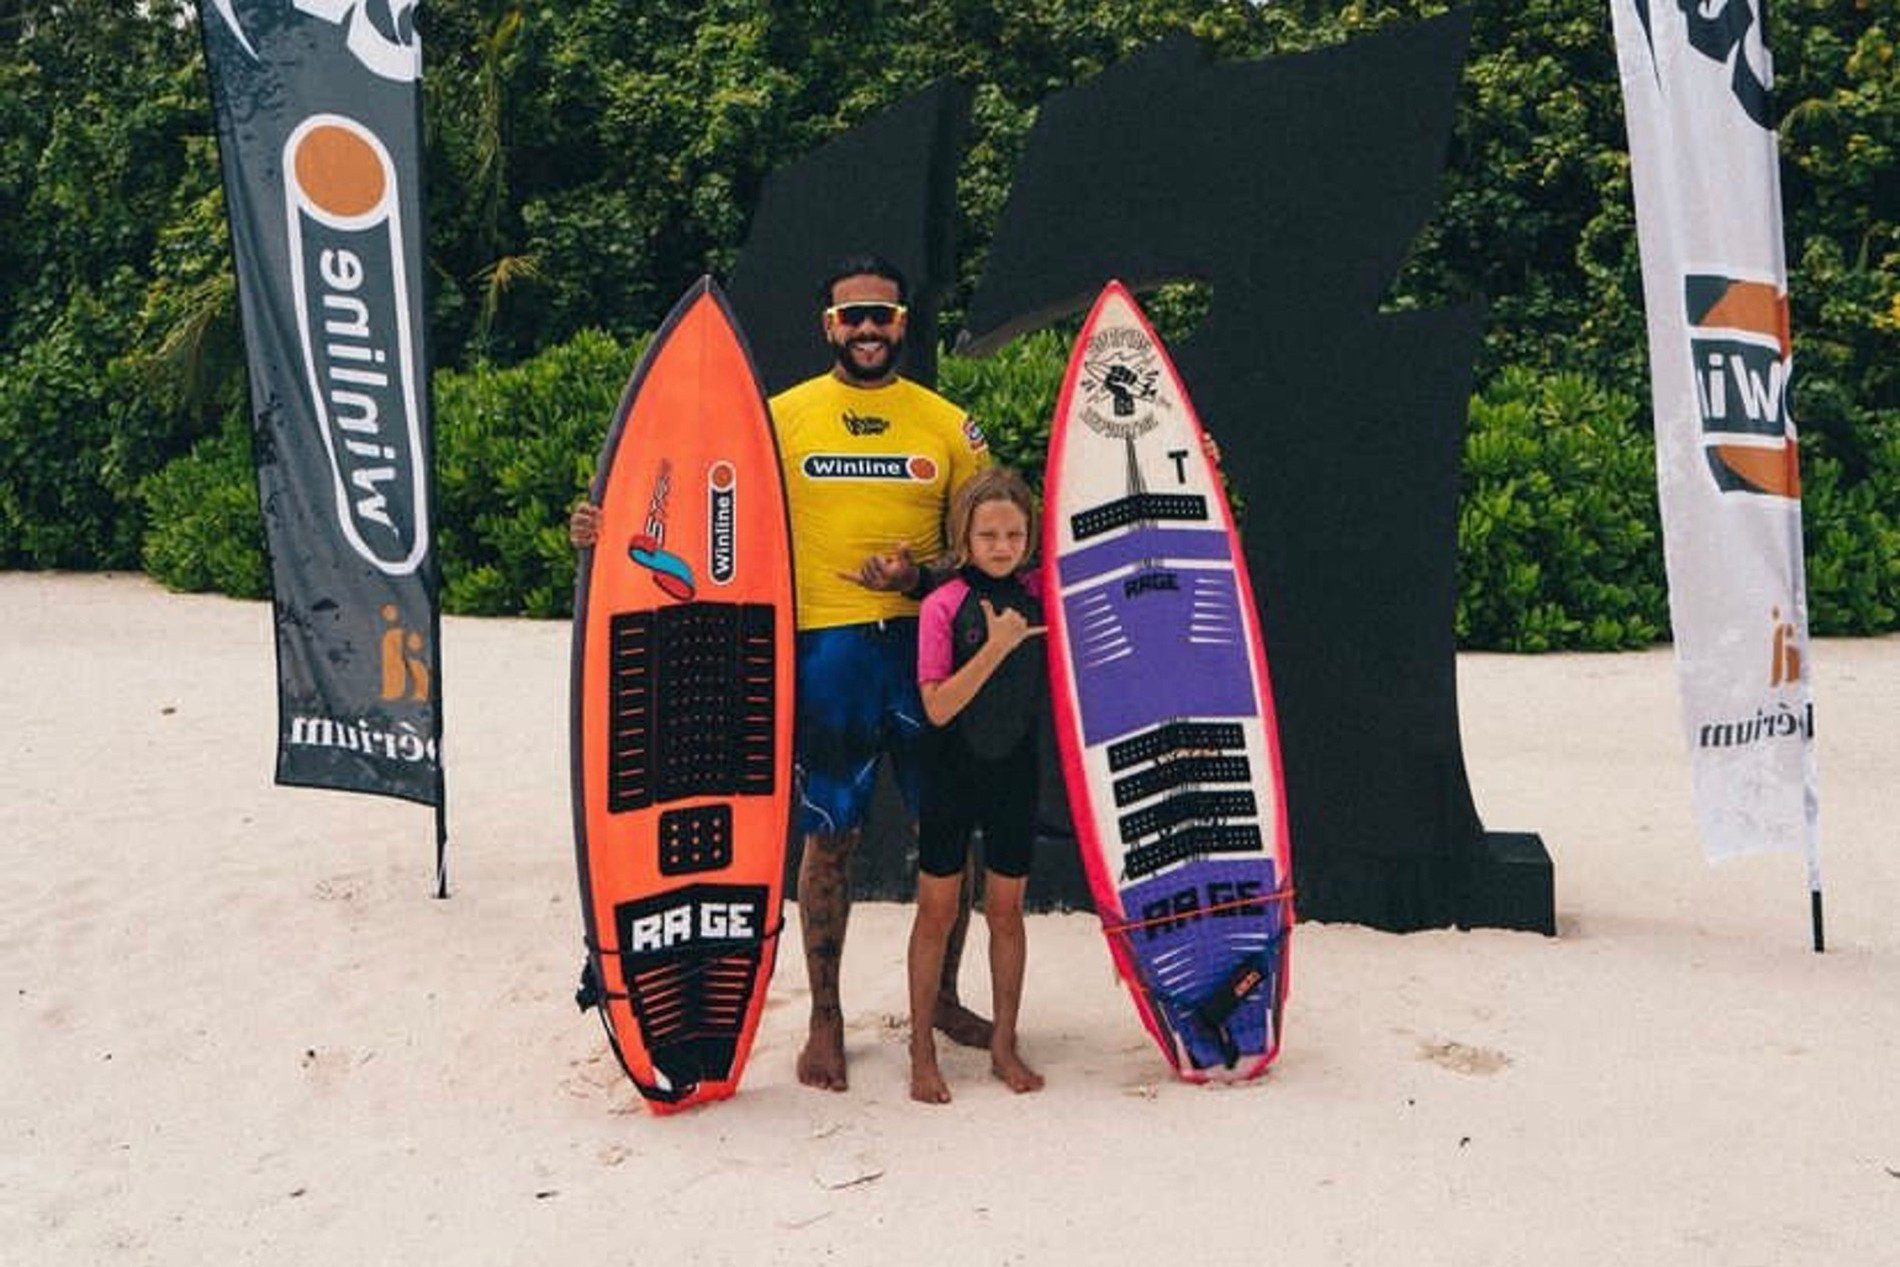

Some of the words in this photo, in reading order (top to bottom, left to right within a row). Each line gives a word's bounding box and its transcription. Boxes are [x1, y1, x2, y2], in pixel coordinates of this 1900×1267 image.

[812, 458, 901, 475] Winline
[1168, 450, 1188, 484] T
[715, 496, 731, 574] Winline
[1124, 573, 1180, 600] RAGE
[632, 902, 754, 951] RAGE
